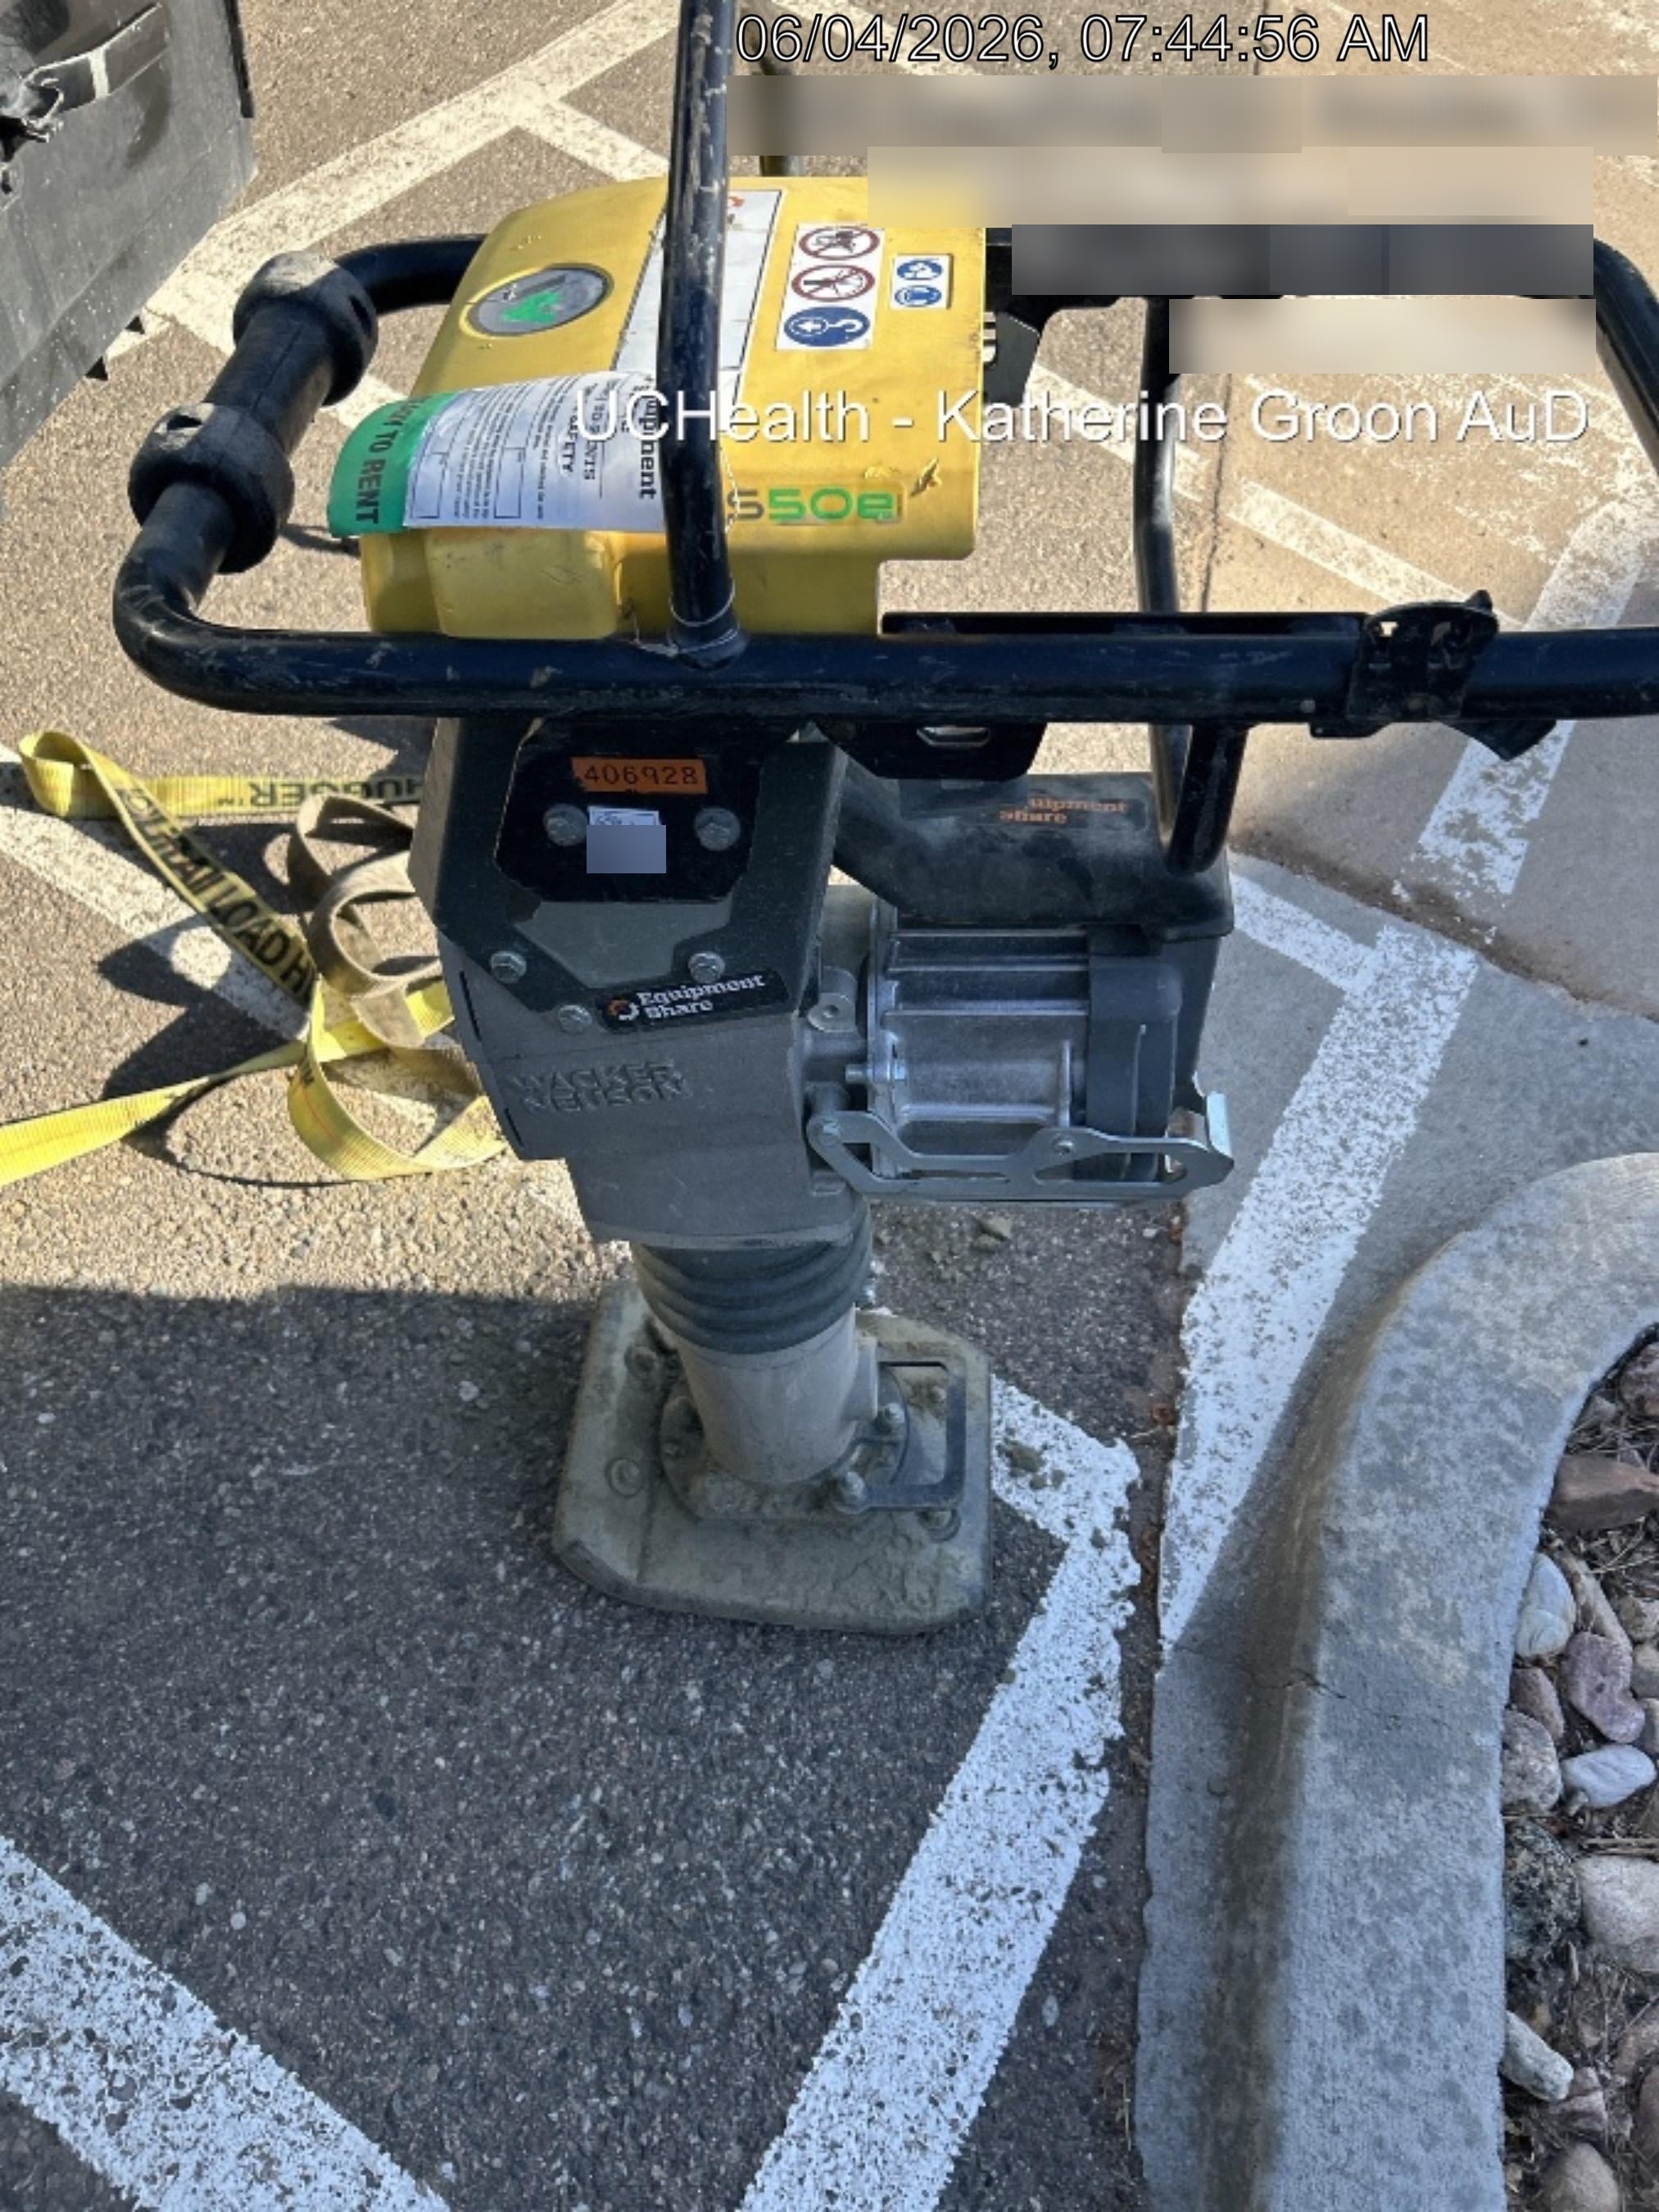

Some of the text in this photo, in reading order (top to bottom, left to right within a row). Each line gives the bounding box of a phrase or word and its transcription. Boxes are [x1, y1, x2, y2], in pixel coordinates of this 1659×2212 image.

[355, 458, 387, 524] RENT
[583, 764, 698, 786] 406928
[636, 974, 765, 1007] Equipment
[644, 999, 714, 1020] Share
